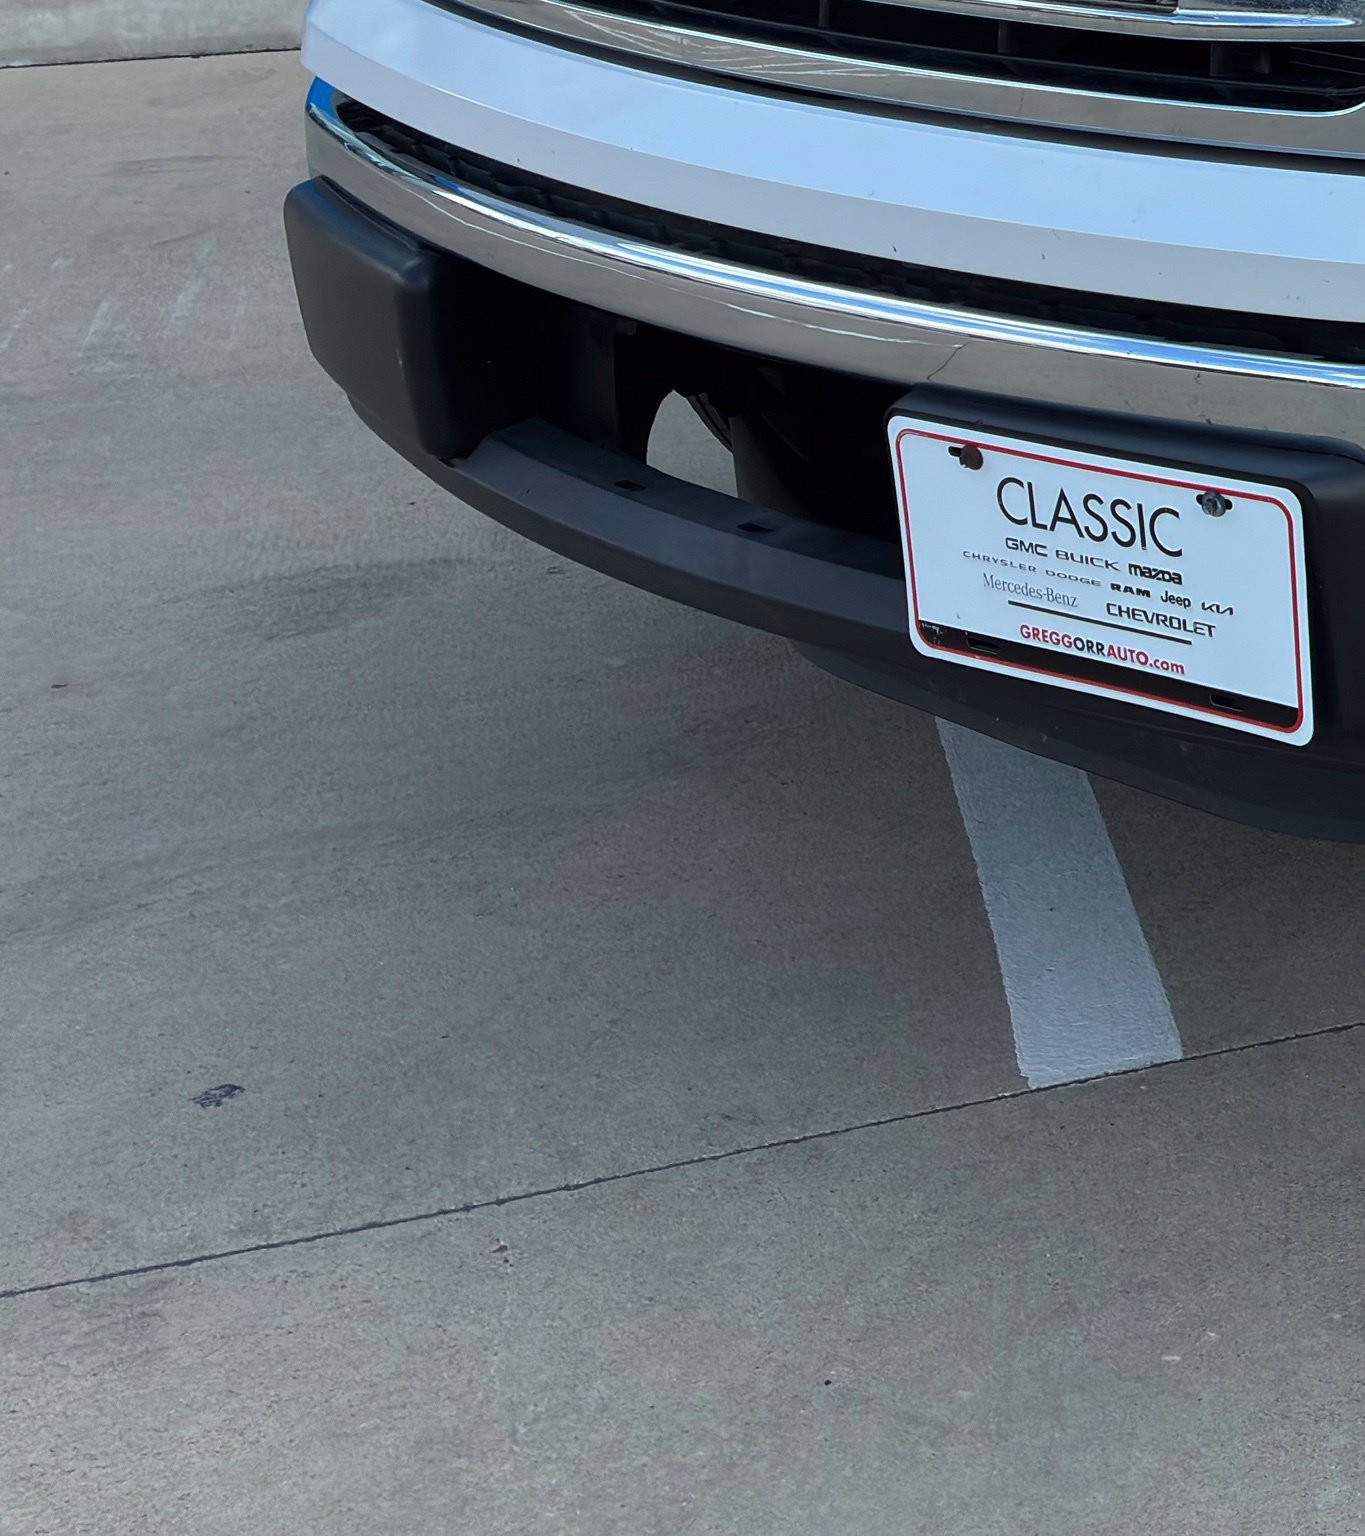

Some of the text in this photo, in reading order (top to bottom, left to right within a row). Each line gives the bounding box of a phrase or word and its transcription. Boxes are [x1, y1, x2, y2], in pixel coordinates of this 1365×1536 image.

[996, 476, 1183, 557] CLASSIC
[962, 550, 1234, 616] CHRYSLER DODGE RAM Jeep KIA
[1005, 537, 1183, 586] GMC BUICK mazda
[982, 572, 1216, 638] Mercedes-Benz CHEVROLET
[1019, 624, 1185, 675] GREGGORRAUTO.com
